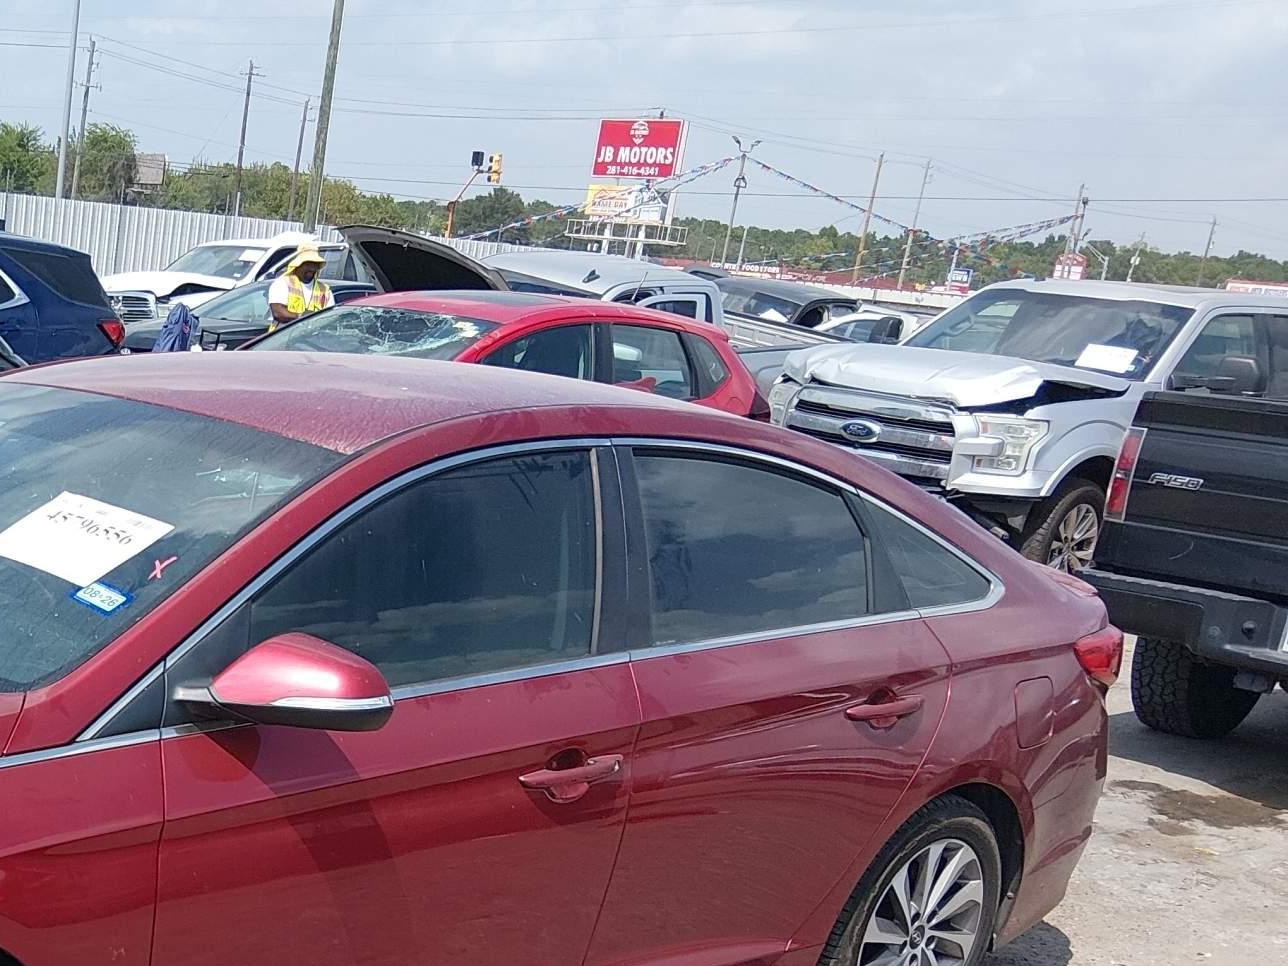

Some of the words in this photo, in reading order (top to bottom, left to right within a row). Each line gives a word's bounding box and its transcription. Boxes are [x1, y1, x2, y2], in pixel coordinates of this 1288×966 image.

[597, 146, 614, 163] JB
[617, 146, 674, 165] MOTORS
[606, 166, 659, 176] 281-416-4341
